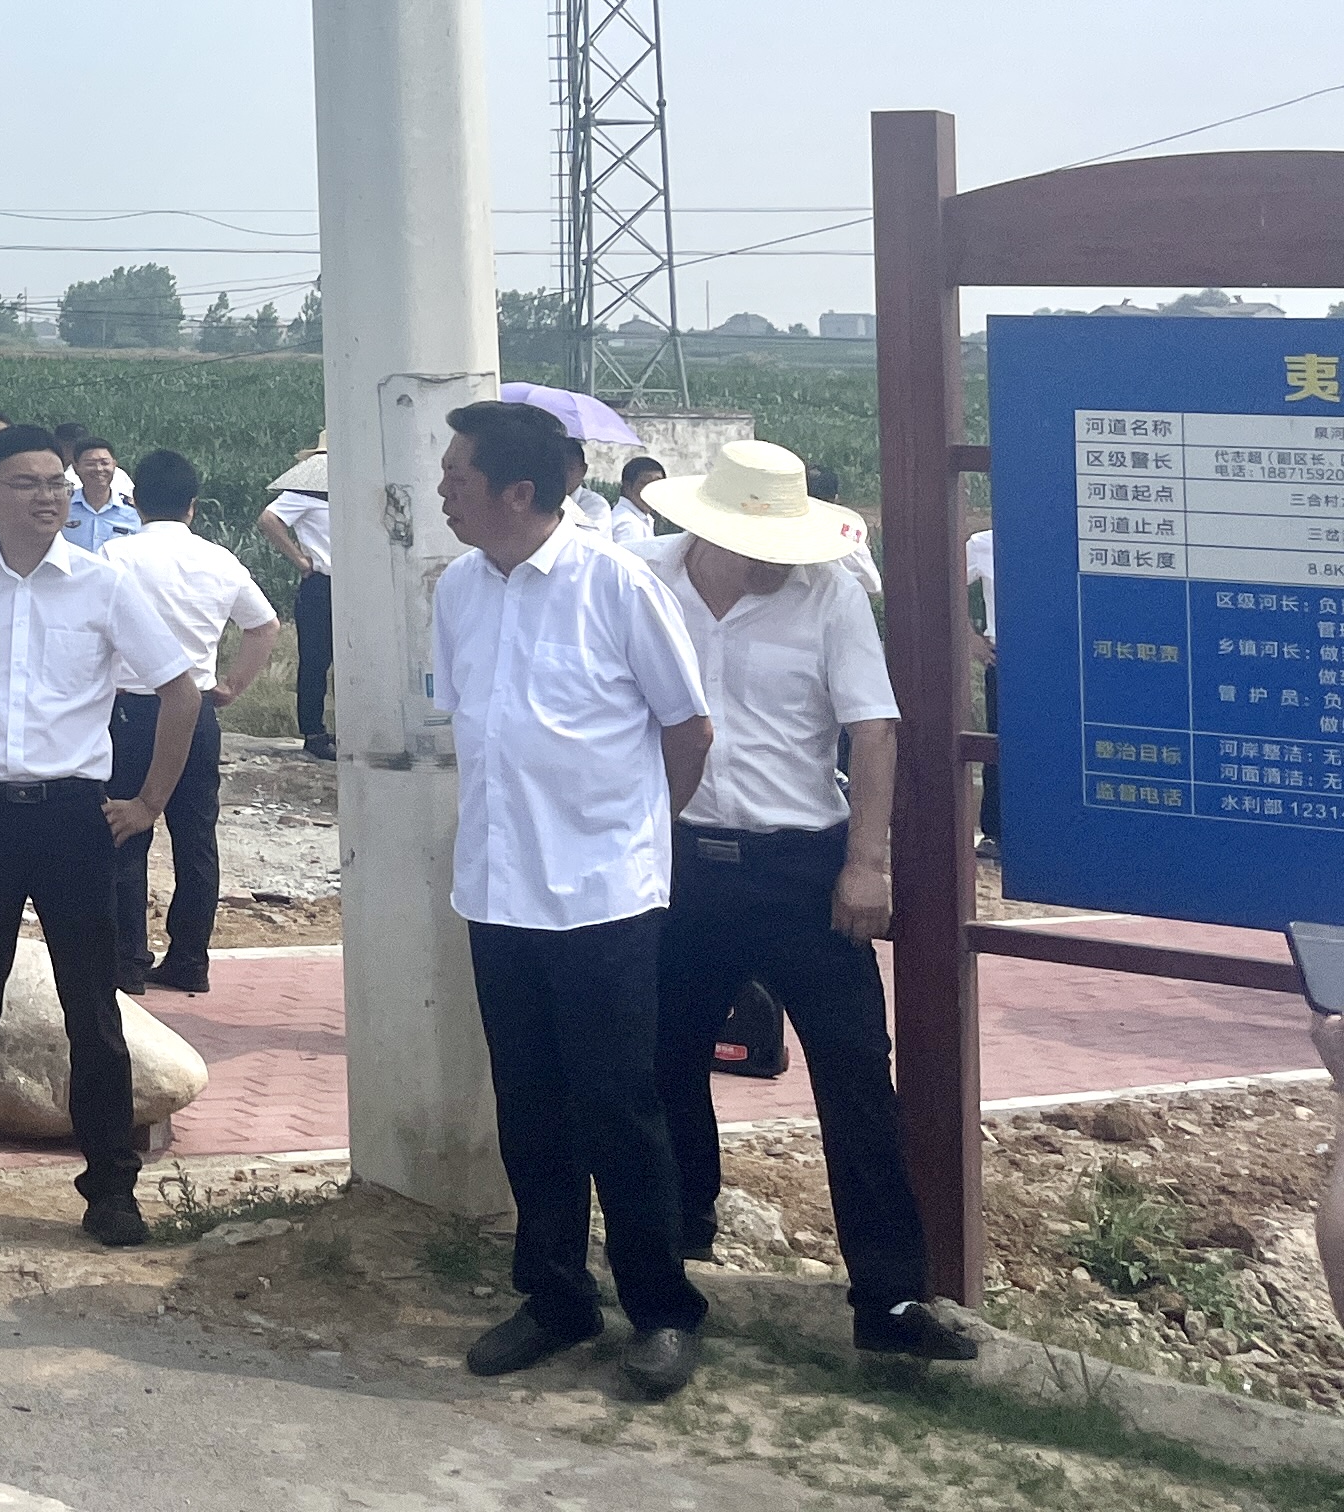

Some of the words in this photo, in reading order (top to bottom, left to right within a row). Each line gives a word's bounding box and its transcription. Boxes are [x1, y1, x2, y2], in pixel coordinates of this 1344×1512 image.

[1284, 353, 1341, 403] 夷
[1085, 417, 1173, 438] 河道名称
[1086, 450, 1173, 470] 区级警长
[1087, 482, 1174, 503] 河道起点
[1290, 493, 1344, 508] 三合村
[1088, 515, 1175, 536] 河道止点
[1307, 527, 1344, 542] 三岔
[1088, 548, 1176, 570] 河道长度
[1216, 591, 1344, 616] 区级河长：负
[1092, 640, 1179, 663] 河长职责
[1217, 638, 1344, 663] 乡镇河长：做
[1319, 669, 1344, 686] 做
[1320, 715, 1344, 734] 做
[1095, 740, 1182, 765] 整治目标
[1096, 782, 1182, 807] 监督电话
[1221, 794, 1283, 815] 水利部
[1290, 802, 1344, 820] 1231
